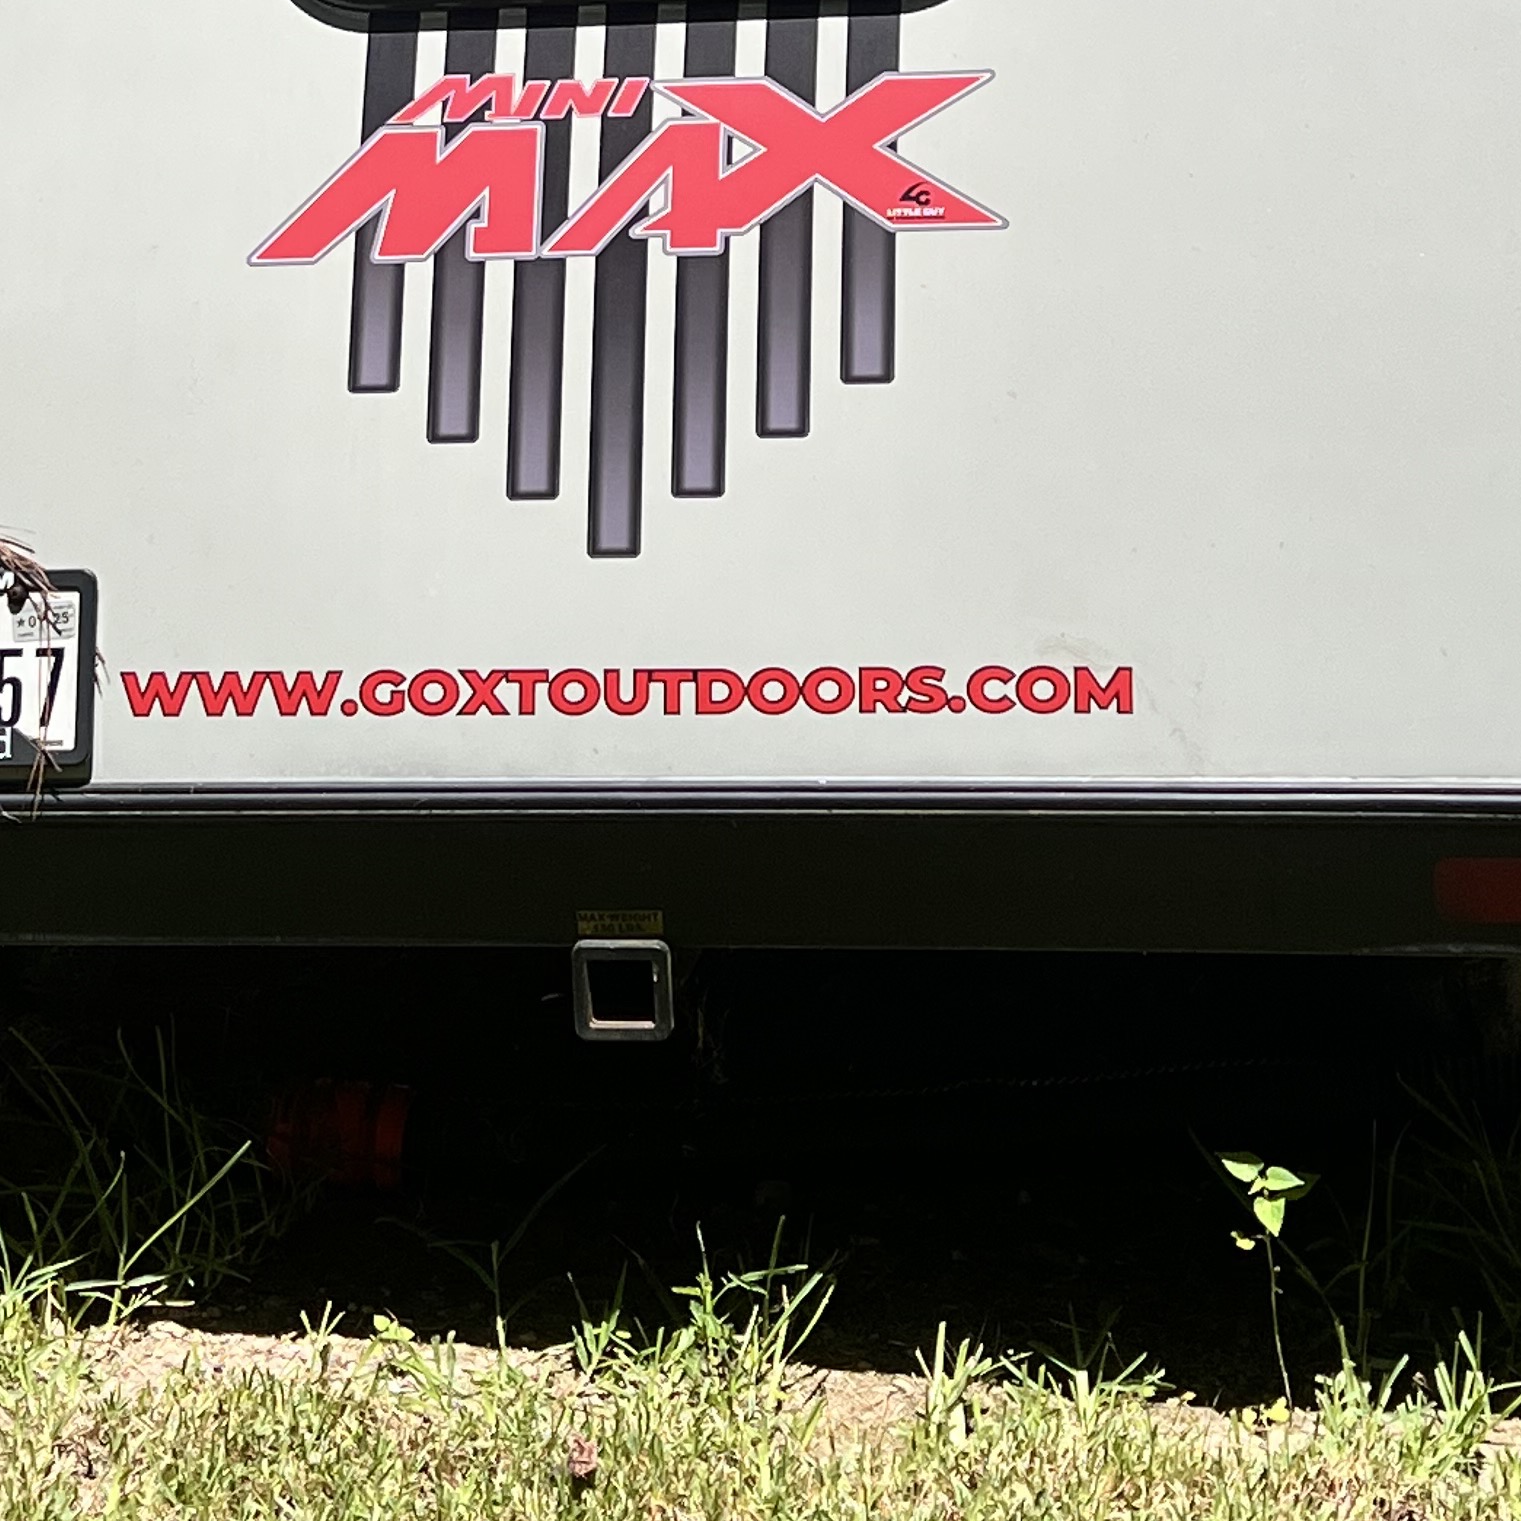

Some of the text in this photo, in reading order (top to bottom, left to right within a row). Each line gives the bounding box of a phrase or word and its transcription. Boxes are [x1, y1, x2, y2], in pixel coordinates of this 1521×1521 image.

[391, 72, 650, 124] MINI
[247, 69, 1008, 266] MAX
[118, 666, 1135, 717] WWW.GOXTOUTDOORS.COM
